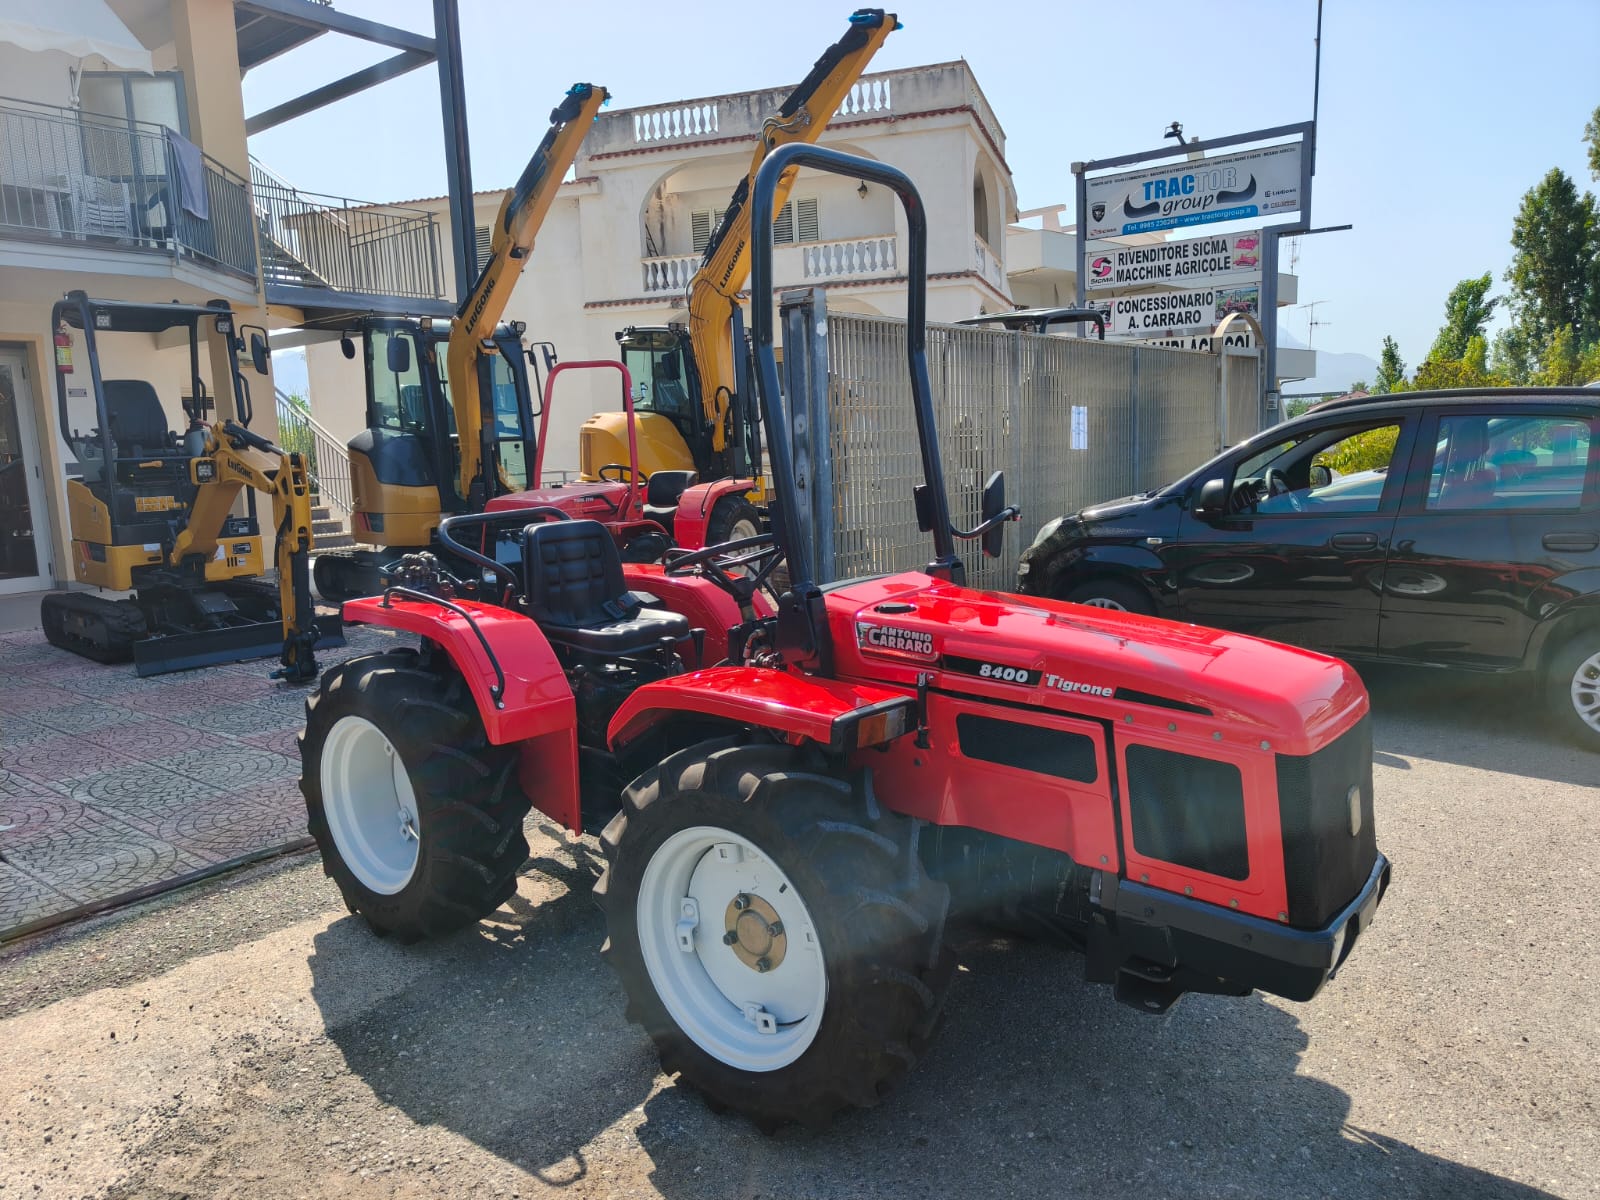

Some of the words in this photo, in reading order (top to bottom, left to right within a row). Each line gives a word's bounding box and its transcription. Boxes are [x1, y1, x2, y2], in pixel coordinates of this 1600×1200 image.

[1142, 167, 1237, 201] TRACTOR
[1162, 191, 1215, 217] group
[1183, 207, 1252, 224] www.tractorgroup.it
[1118, 243, 1189, 267] RIVENDITORE
[1192, 239, 1228, 256] SICMA
[1116, 263, 1172, 283] MACCHINE
[1174, 255, 1231, 275] AGRICOLE
[1117, 291, 1213, 315] CONCESSIONARIO
[1128, 317, 1139, 329] A.
[1143, 308, 1202, 328] CARRARO
[868, 628, 934, 655] CARRARO
[880, 625, 933, 643] ANTONIO
[979, 663, 1029, 683] 8400
[1045, 672, 1113, 697] Tigrone
